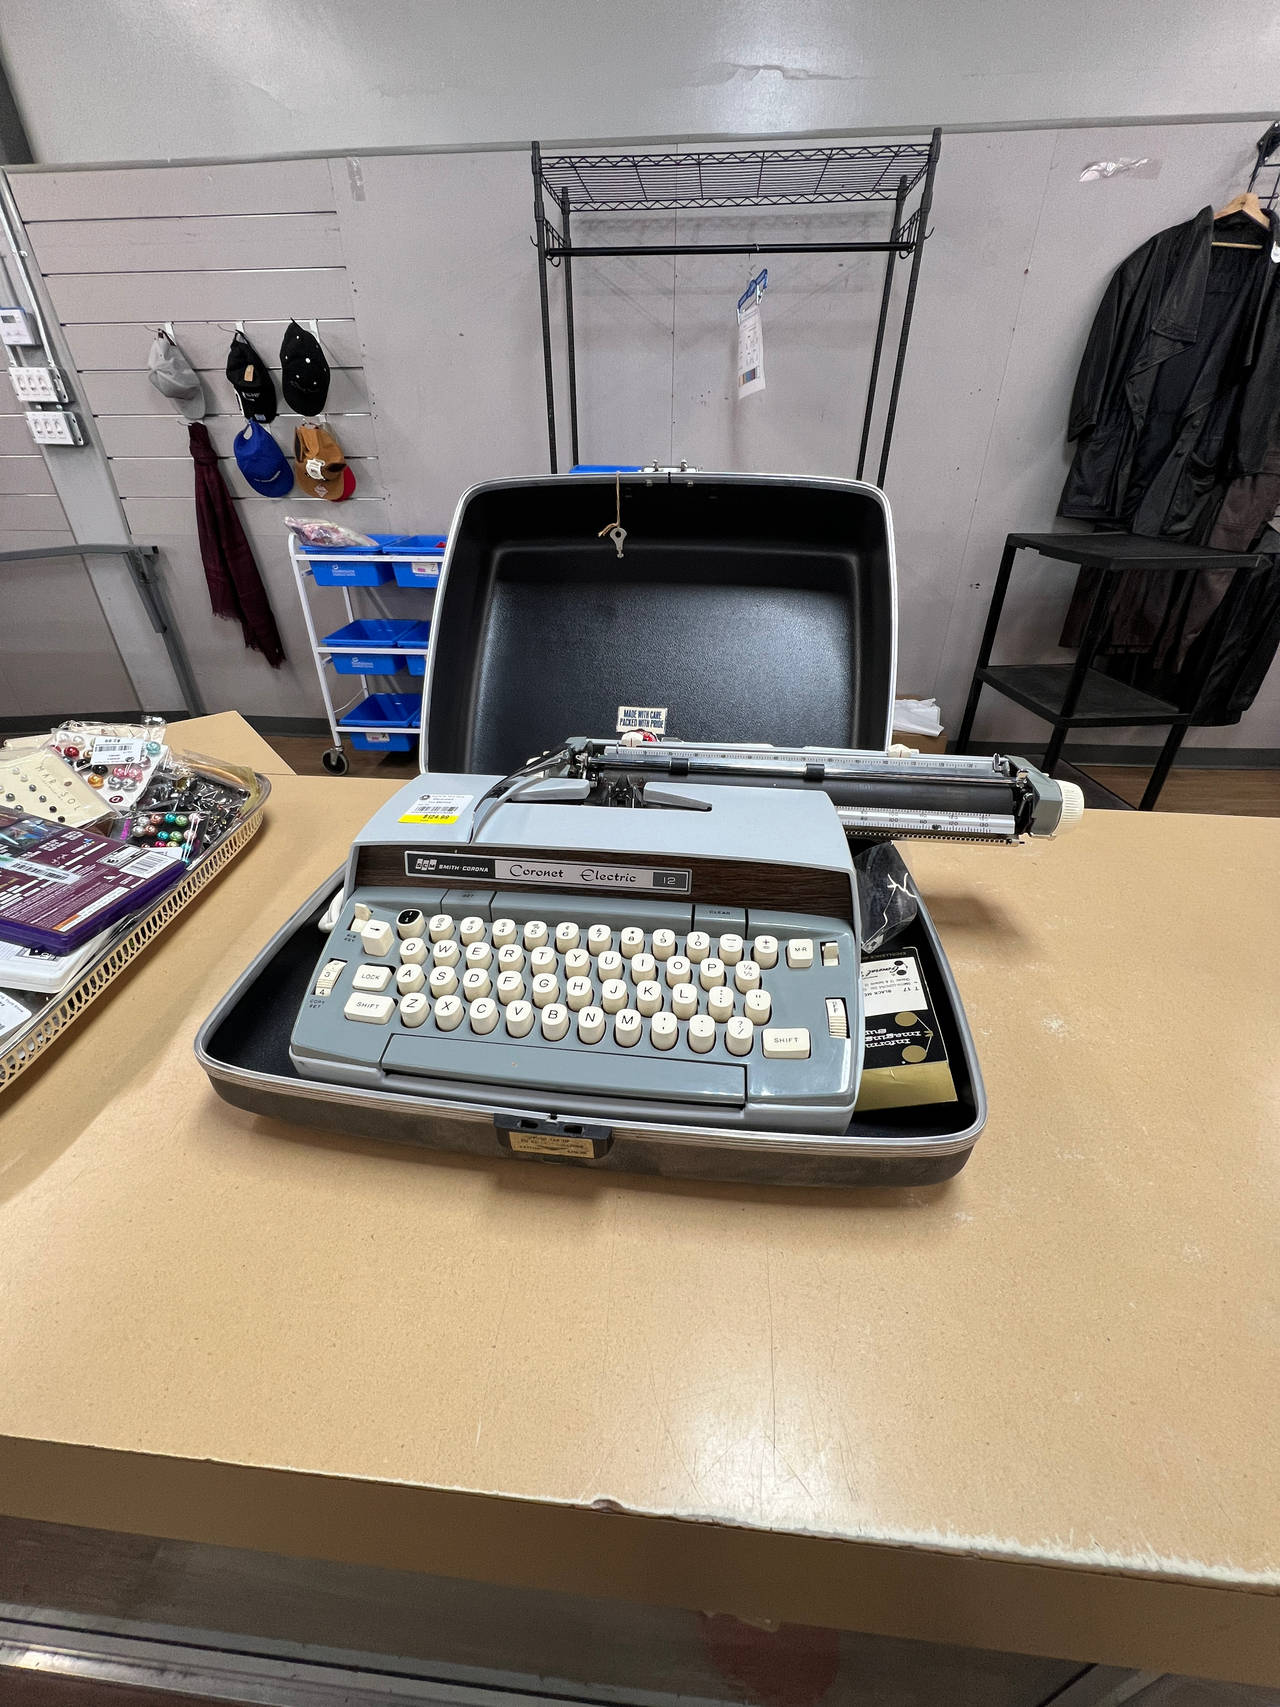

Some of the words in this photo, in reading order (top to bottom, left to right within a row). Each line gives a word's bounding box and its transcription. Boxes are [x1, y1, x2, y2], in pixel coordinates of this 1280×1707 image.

[510, 864, 564, 878] Coronet
[580, 868, 636, 882] Electric
[663, 876, 676, 885] 12
[406, 943, 415, 951] Q
[439, 944, 452, 953] W
[472, 947, 482, 955] E
[573, 954, 581, 962] Y
[605, 956, 614, 964] U
[674, 961, 683, 970] O
[707, 963, 716, 972] P
[436, 972, 446, 980] S
[469, 974, 479, 982] D
[503, 976, 513, 985] F
[539, 979, 549, 988] G
[573, 982, 583, 991] H
[610, 985, 618, 994] J
[644, 986, 653, 995] K
[680, 989, 688, 998] L
[408, 999, 418, 1008] Z
[441, 1001, 452, 1011] X
[477, 1004, 486, 1013] C
[515, 1007, 524, 1016] V
[548, 1010, 558, 1019] B
[585, 1013, 595, 1023] N
[622, 1016, 633, 1025] M
